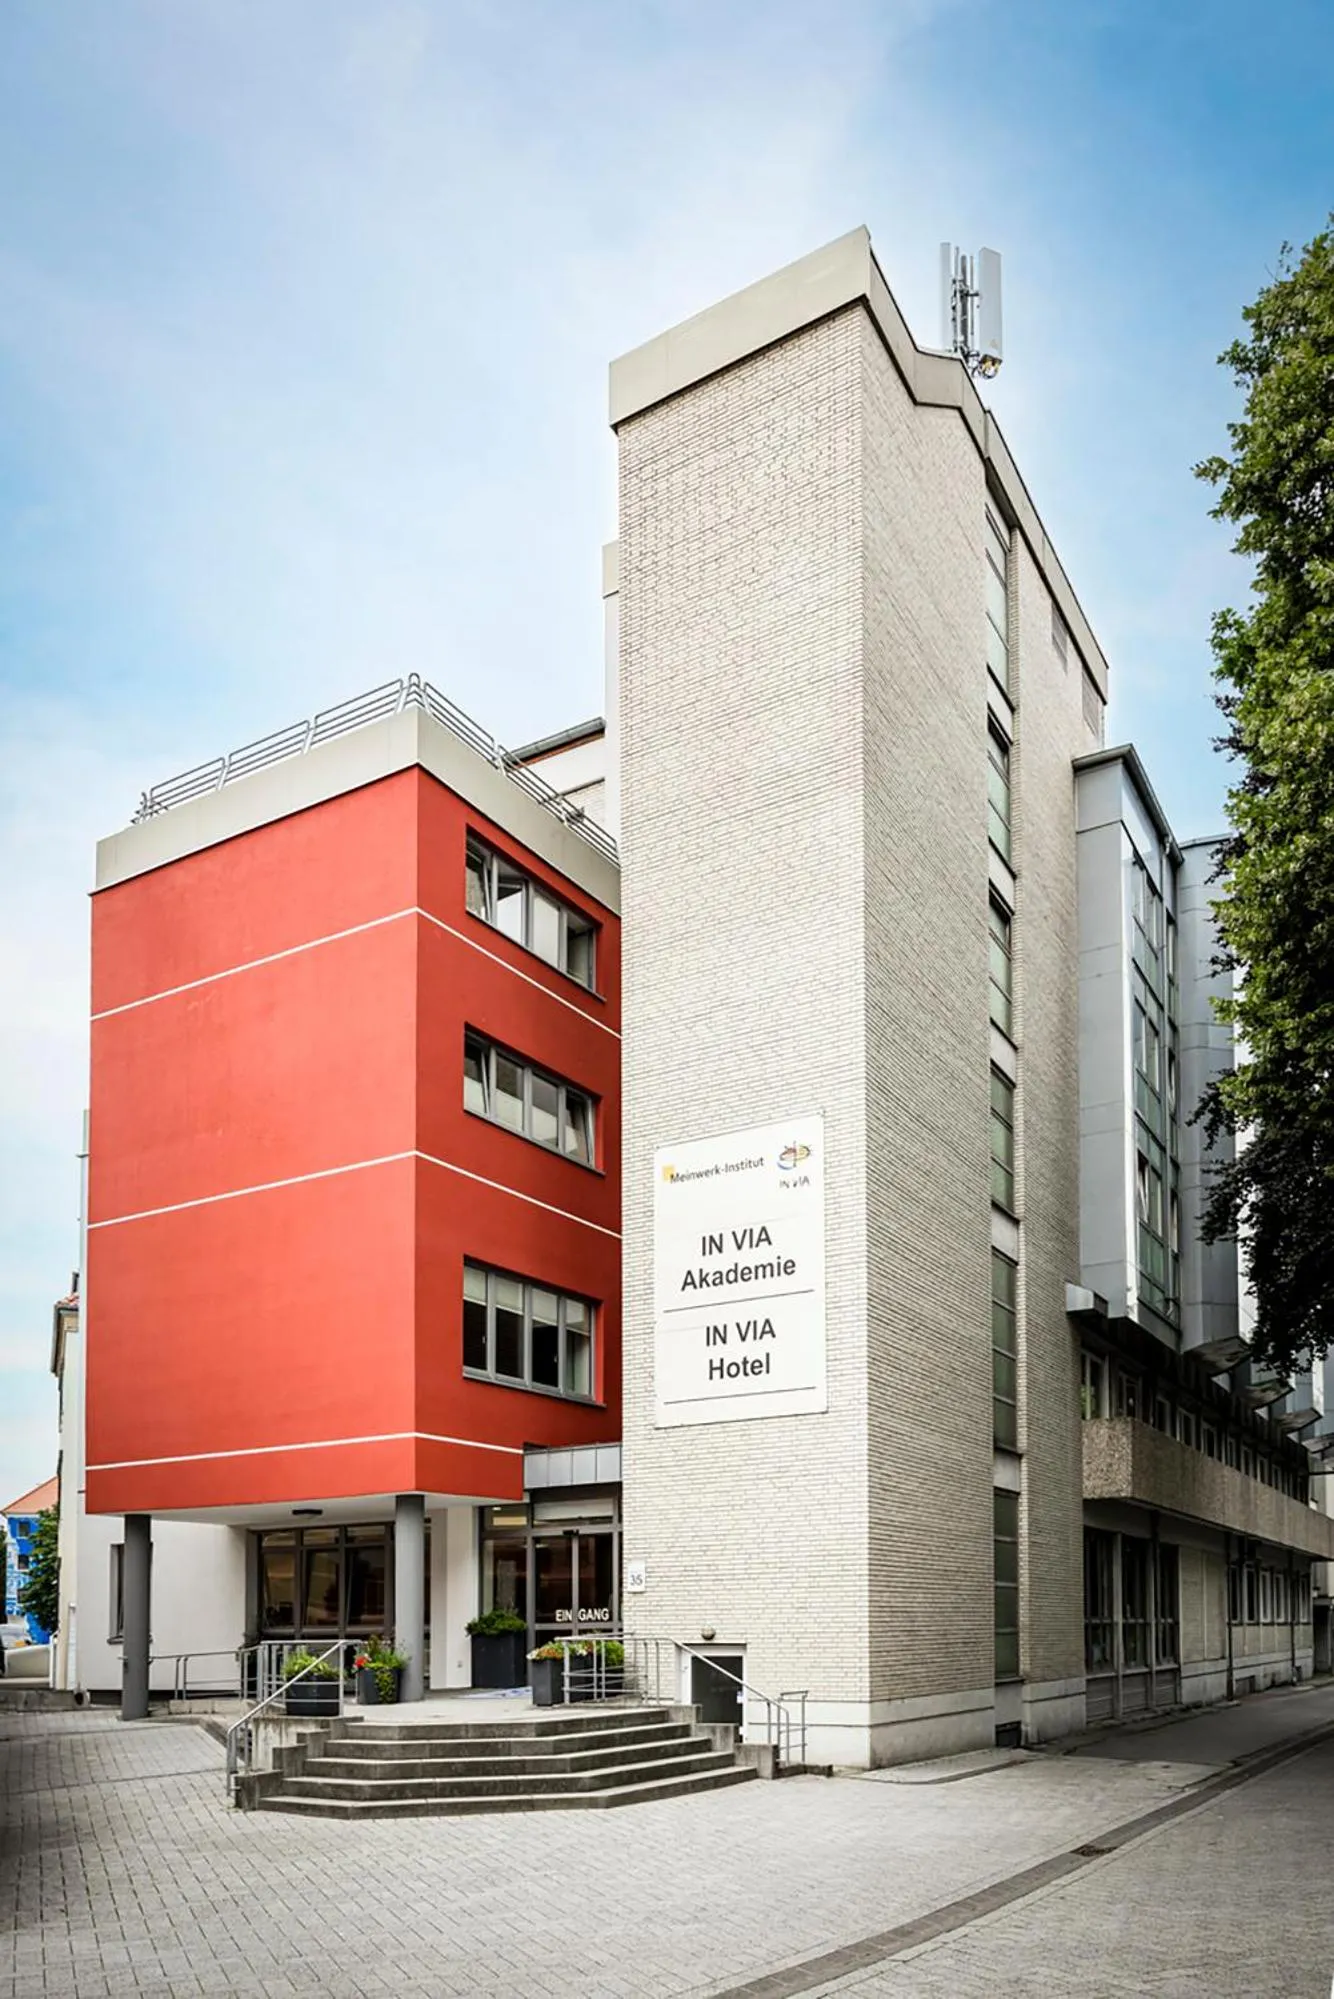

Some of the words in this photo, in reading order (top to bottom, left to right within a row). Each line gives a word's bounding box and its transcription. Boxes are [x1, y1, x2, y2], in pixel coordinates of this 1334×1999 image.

[670, 1157, 765, 1184] Meinwerk-Institut
[701, 1233, 724, 1256] IN
[732, 1226, 773, 1250] VIA
[681, 1256, 797, 1291] Akademie
[706, 1324, 728, 1347] IN
[736, 1318, 777, 1342] VIA
[708, 1352, 771, 1381] Hotel
[630, 1574, 643, 1586] 35
